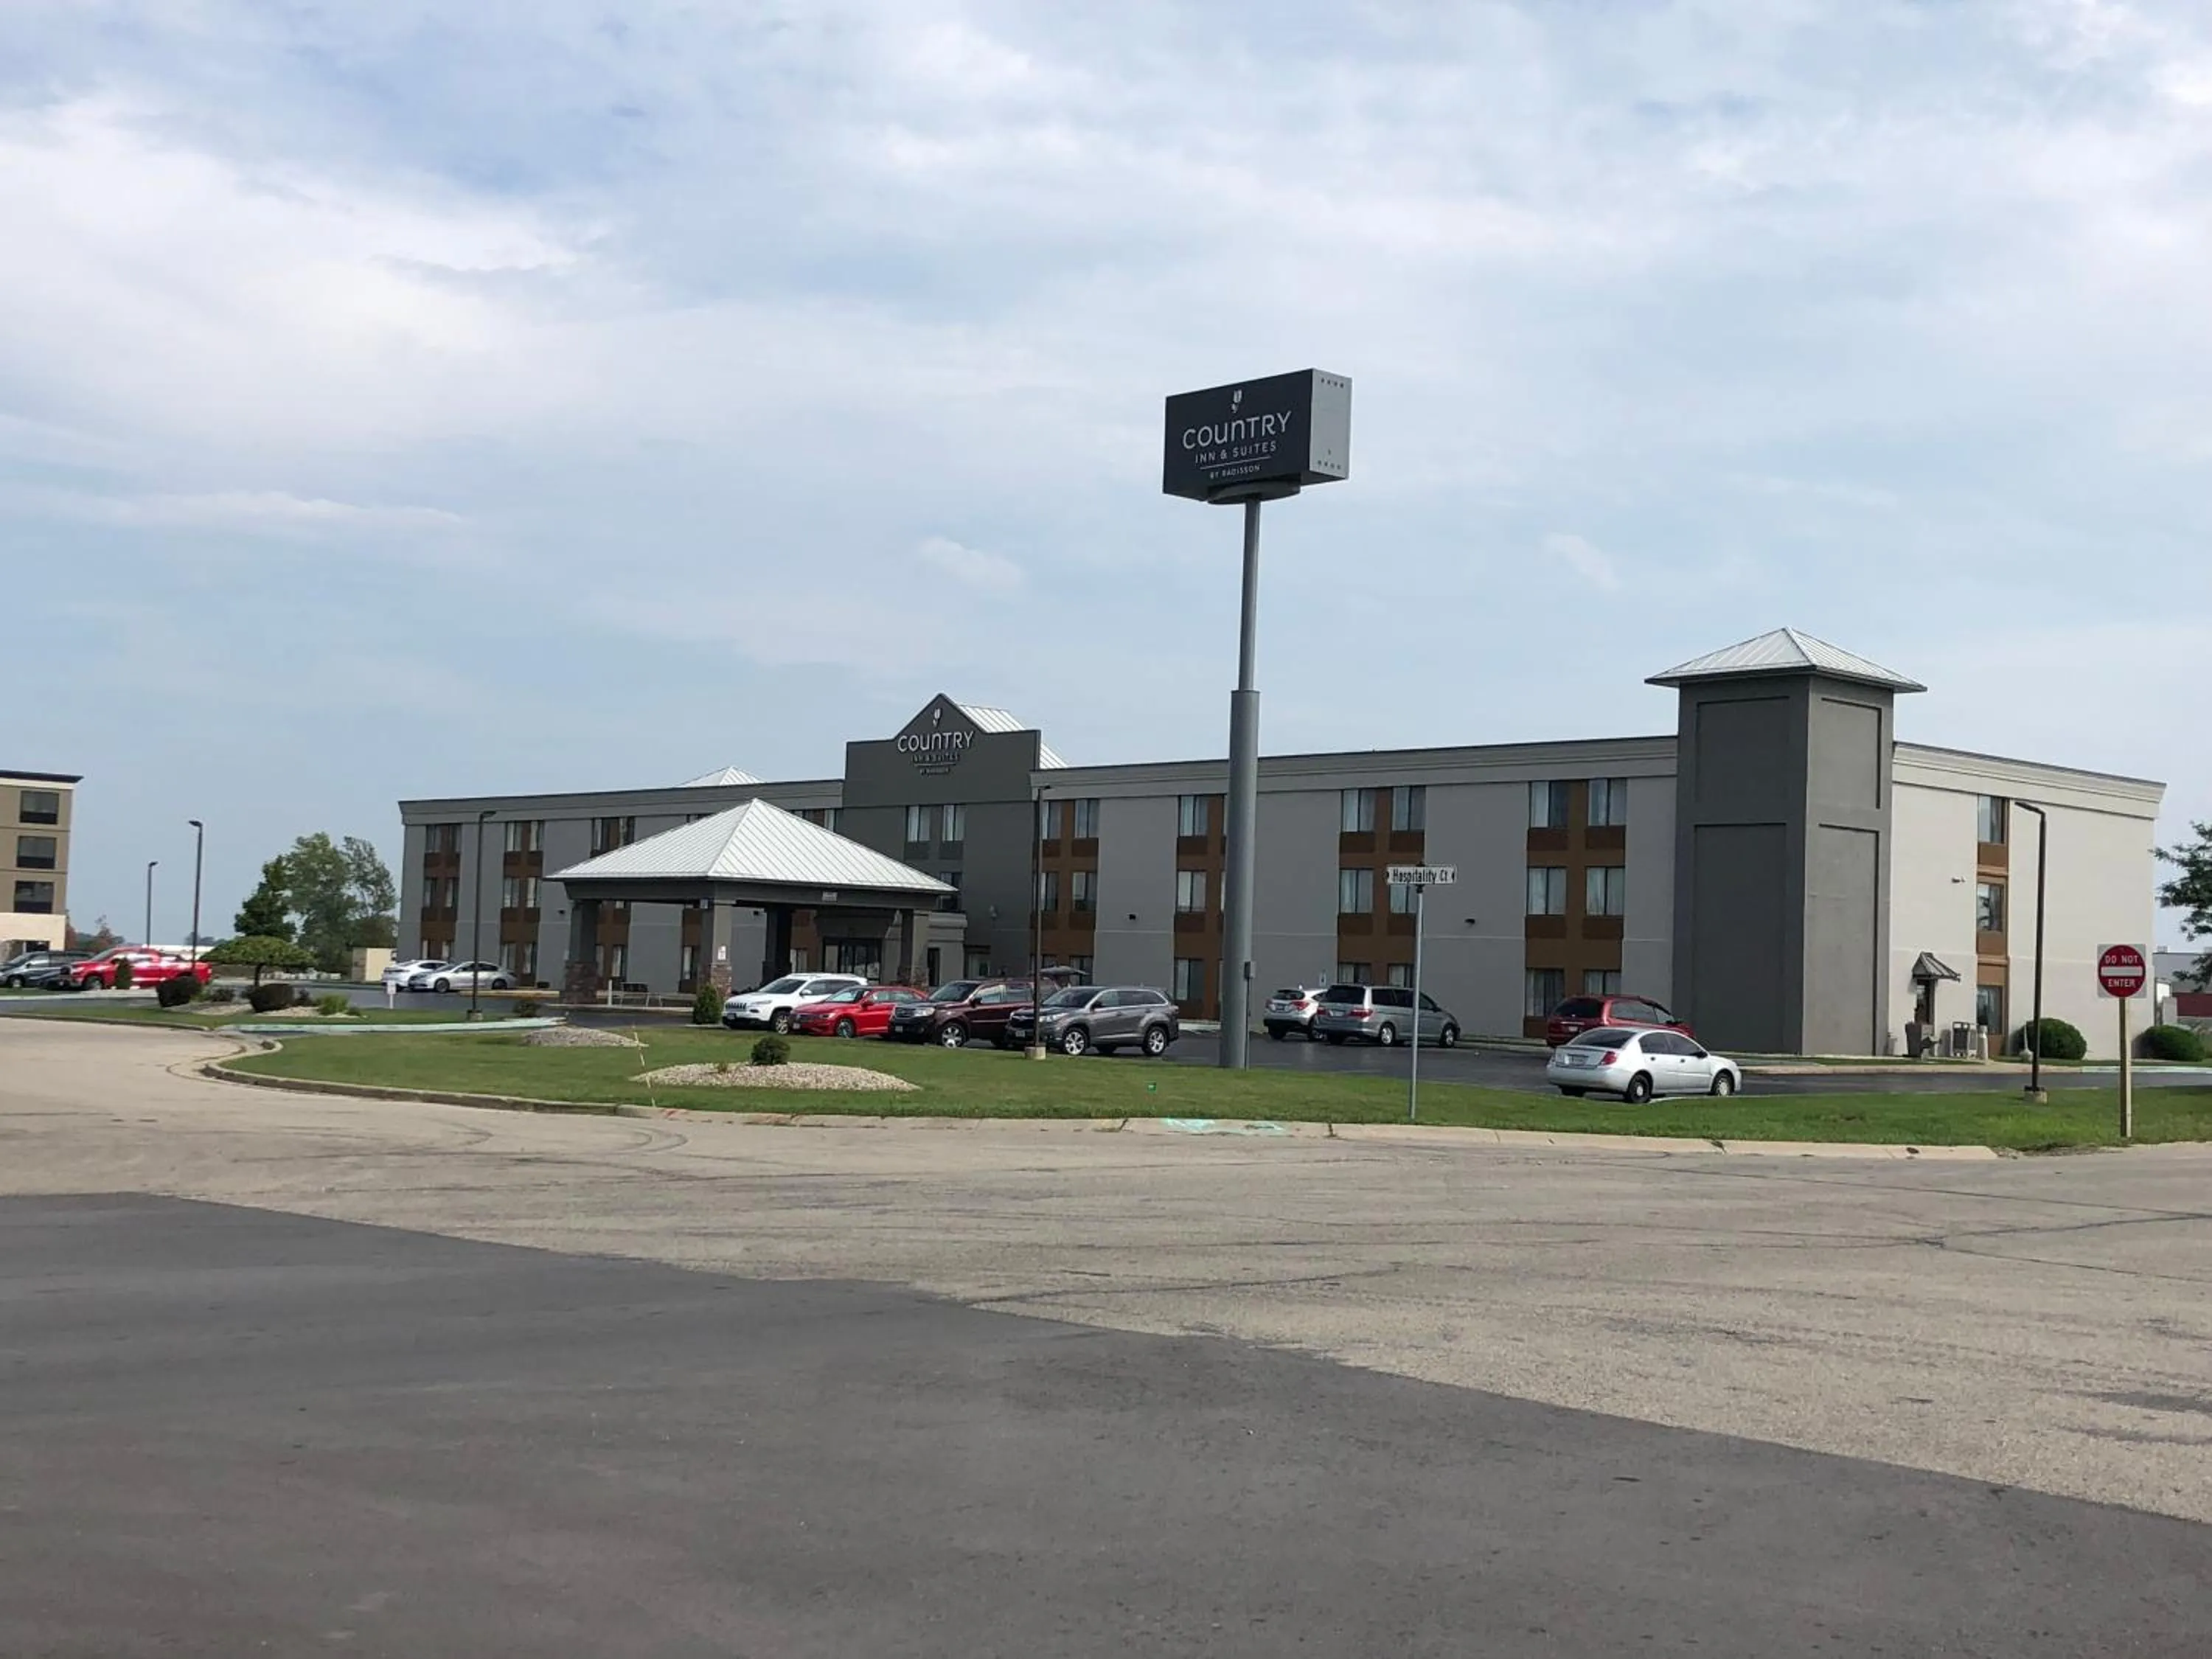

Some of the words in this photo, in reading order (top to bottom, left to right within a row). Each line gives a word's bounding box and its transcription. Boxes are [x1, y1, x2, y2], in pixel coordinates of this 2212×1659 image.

[1195, 451, 1216, 464] INN
[1220, 449, 1227, 459] &
[1232, 441, 1276, 458] SUITES
[1393, 869, 1436, 884] Hospitality
[2105, 955, 2117, 964] DO
[2121, 955, 2138, 964] NOT
[2108, 978, 2136, 987] ENTER
